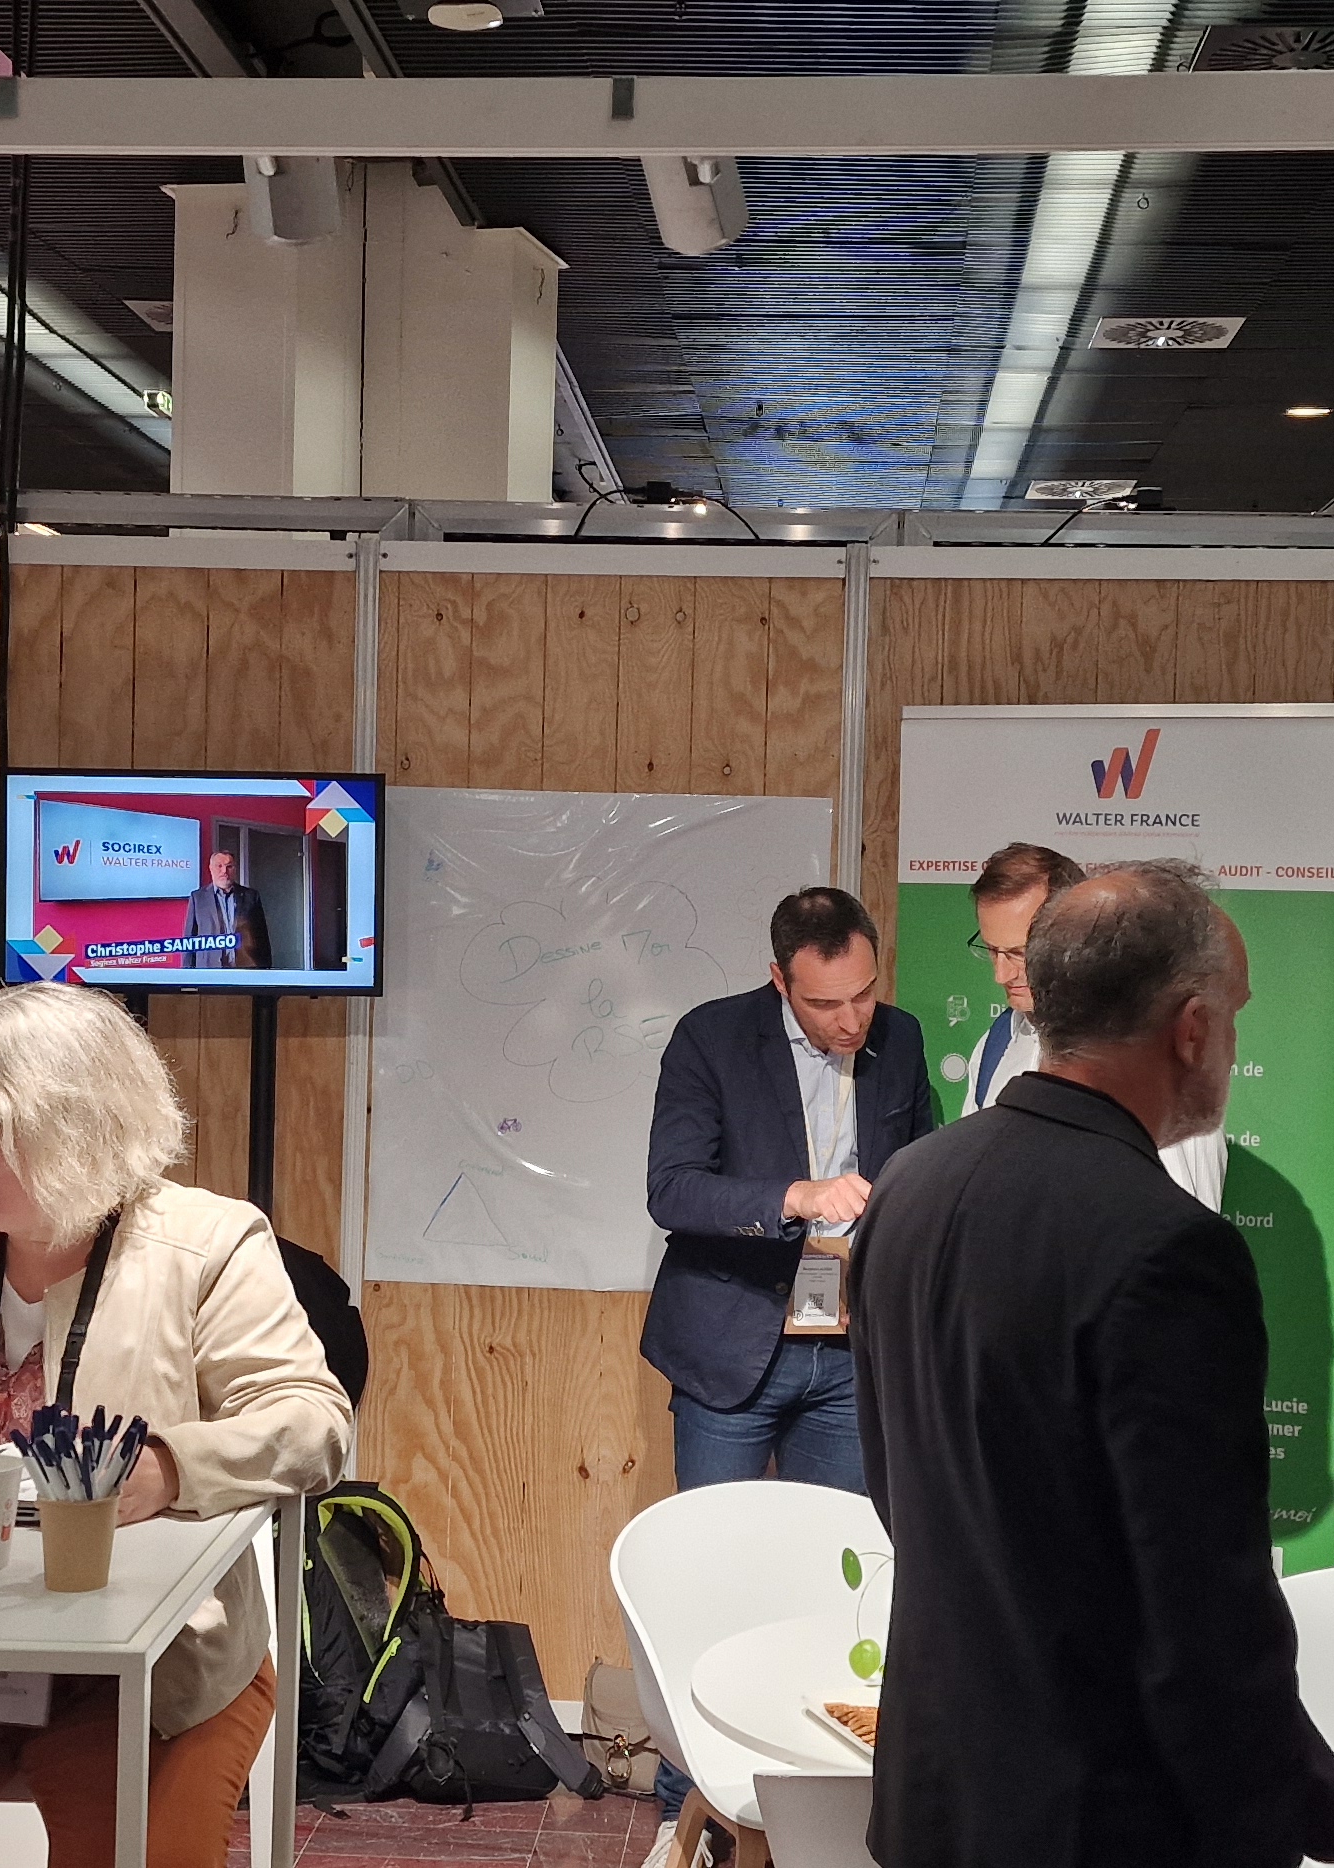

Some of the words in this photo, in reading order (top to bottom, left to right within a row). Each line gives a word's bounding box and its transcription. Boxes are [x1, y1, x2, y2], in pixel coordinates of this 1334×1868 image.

[1056, 812, 1125, 827] WALTER
[1130, 813, 1201, 827] FRANCE
[102, 841, 163, 855] SOGIREX
[102, 856, 148, 867] WALTER
[152, 857, 191, 868] FRANCE
[909, 860, 978, 872] EXPERTISE
[1218, 865, 1263, 877] AUDIT
[87, 940, 161, 958] Christophe
[163, 934, 236, 952] SANTIAGO
[1243, 1060, 1264, 1077] de
[1240, 1130, 1261, 1147] de
[1235, 1210, 1274, 1228] bord
[1263, 1396, 1308, 1414] Lucie
